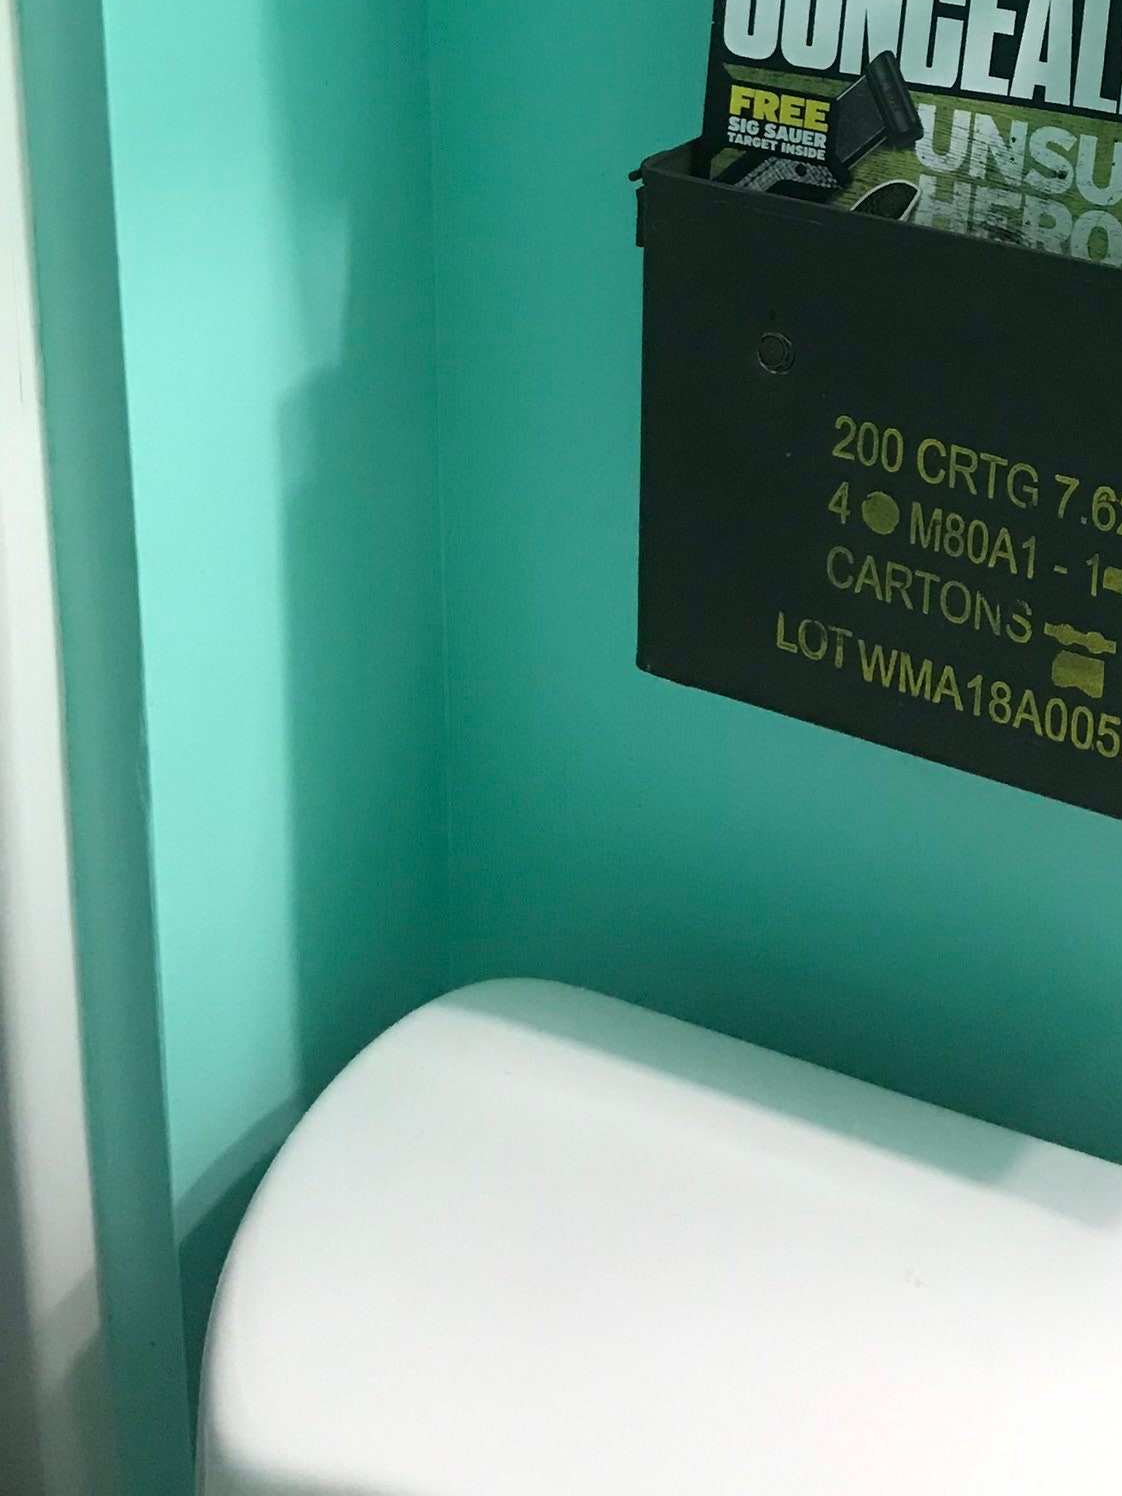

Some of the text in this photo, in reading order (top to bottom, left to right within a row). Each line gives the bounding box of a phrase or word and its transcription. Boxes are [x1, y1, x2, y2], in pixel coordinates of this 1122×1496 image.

[727, 115, 827, 150] SIG SAUER
[729, 84, 831, 133] FREE
[727, 131, 827, 162] TARGET INSIDE
[832, 414, 904, 473] 200
[916, 438, 1039, 509] CRTG
[827, 481, 851, 524] 4
[909, 501, 1037, 580] M80A1
[1086, 554, 1101, 597] 1
[825, 545, 1033, 644] CARTONS
[775, 611, 854, 669] LOT
